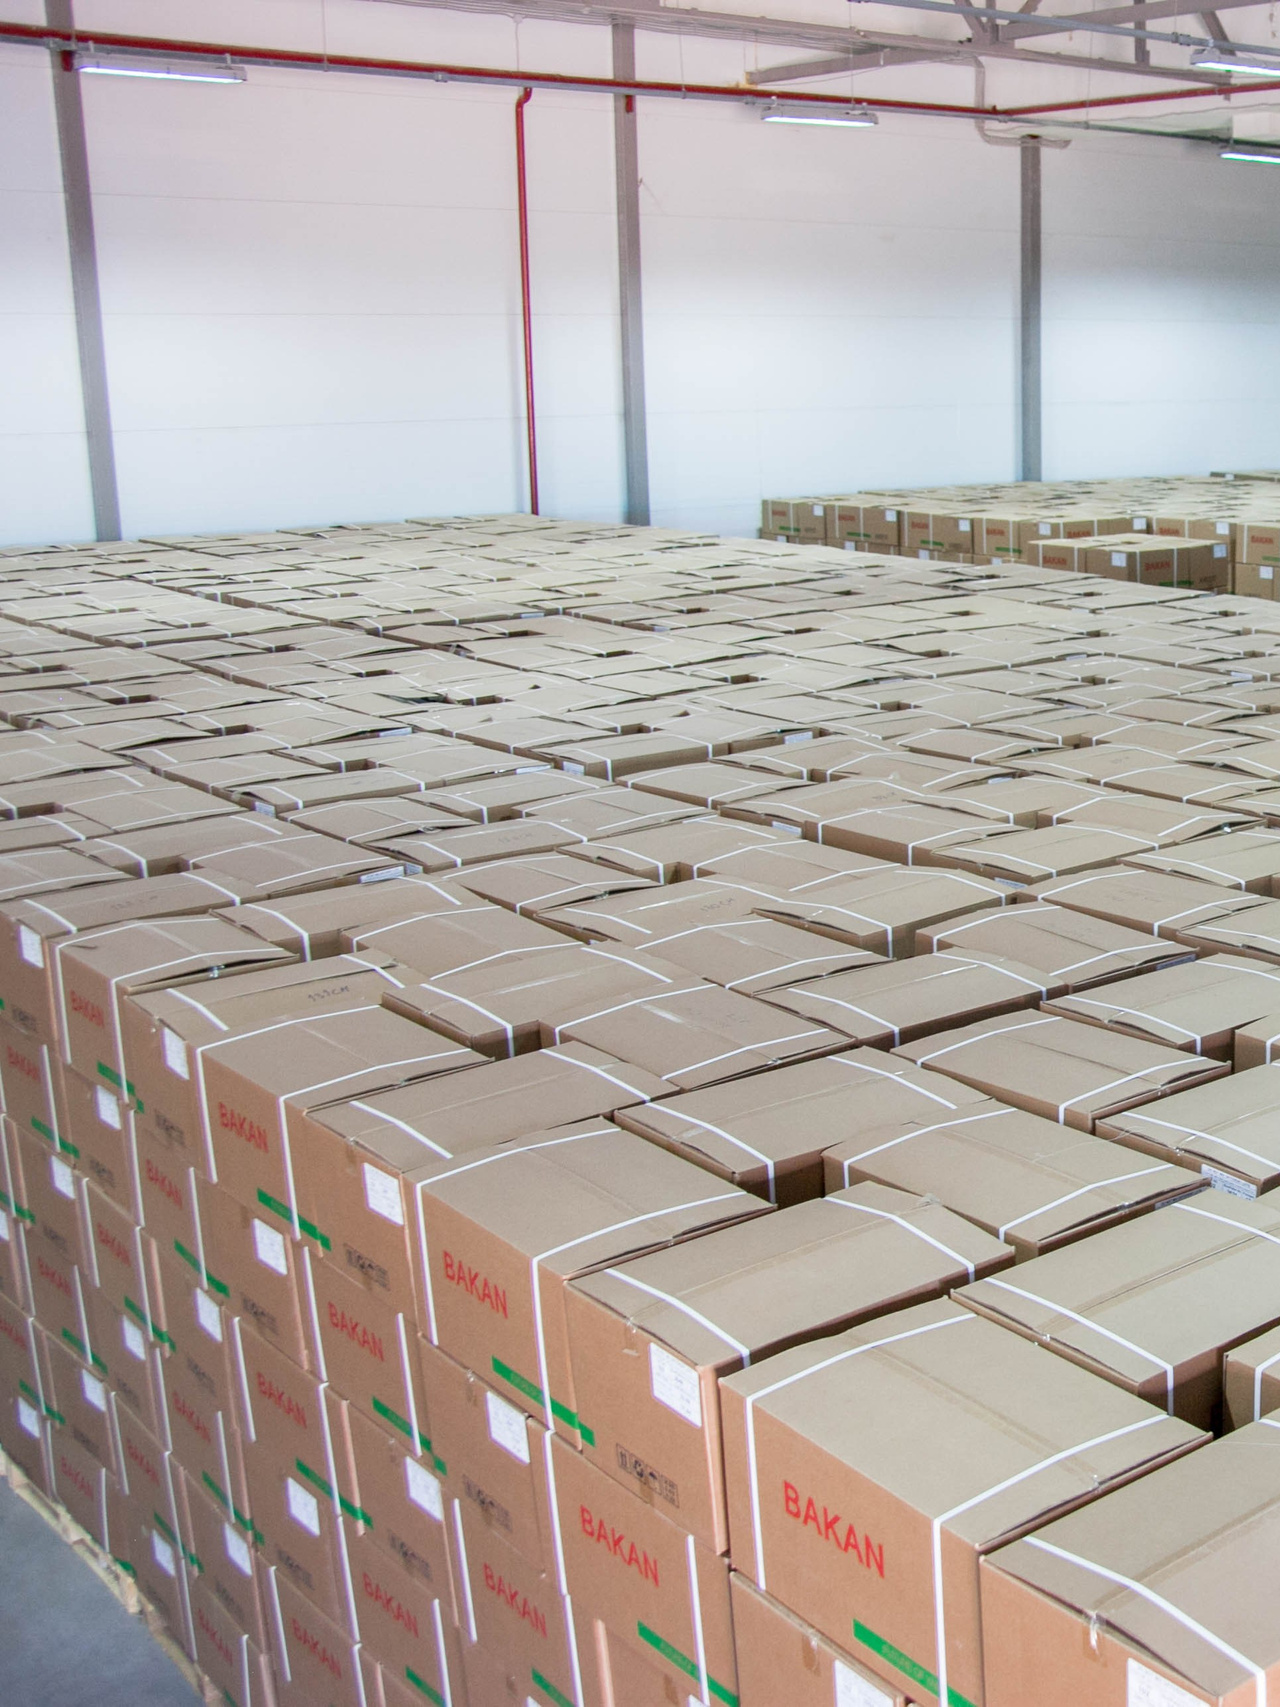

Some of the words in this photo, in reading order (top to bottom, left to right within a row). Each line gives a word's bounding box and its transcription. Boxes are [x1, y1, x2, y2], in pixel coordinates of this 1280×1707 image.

[219, 1103, 268, 1152] BAKAN
[146, 1160, 182, 1206] BAKAN
[443, 1251, 508, 1318] BAKAN
[328, 1303, 384, 1360] BAKAN
[257, 1373, 306, 1427] BAKAN
[580, 1506, 659, 1586] BAKAN
[784, 1481, 884, 1577] BAKAN
[363, 1573, 418, 1637] BAKAN
[483, 1563, 547, 1638] BAKAN
